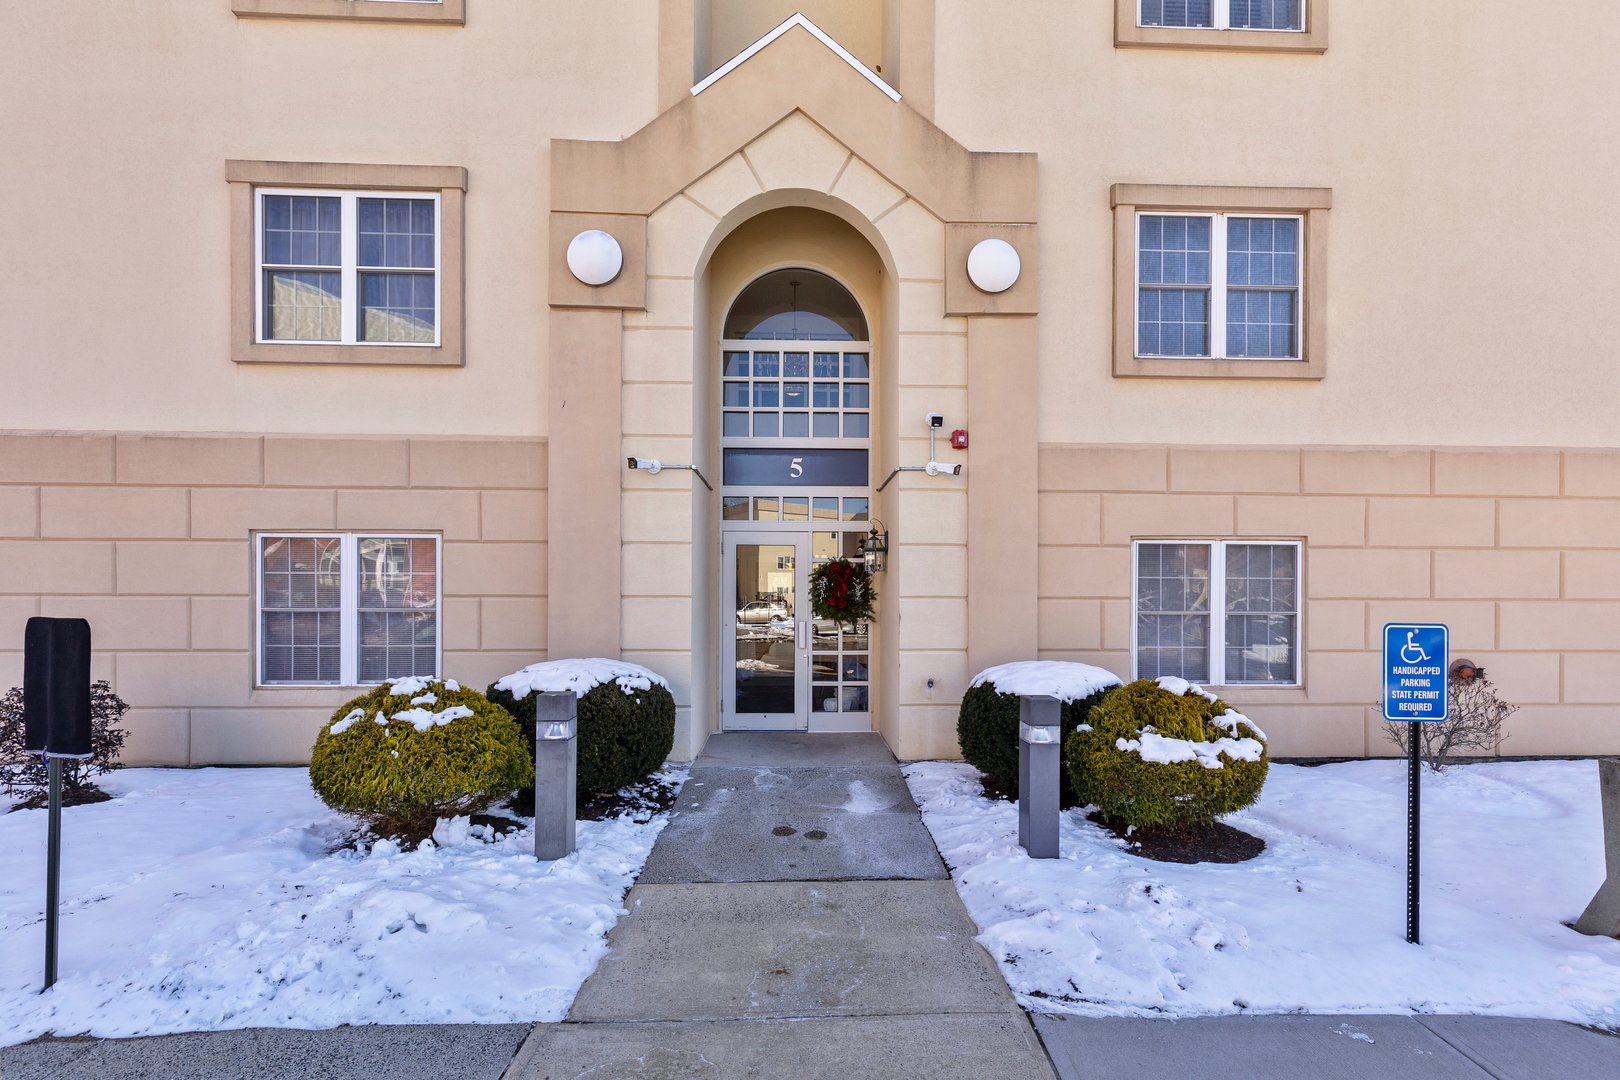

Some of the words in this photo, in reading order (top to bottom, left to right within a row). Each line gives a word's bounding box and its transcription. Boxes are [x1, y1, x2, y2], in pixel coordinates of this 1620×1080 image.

[790, 457, 803, 478] 5
[1392, 666, 1441, 675] HANDICAPPED
[1400, 678, 1431, 687] PARKING
[1391, 690, 1412, 699] STATE
[1413, 690, 1440, 699] PERMIT
[1398, 702, 1433, 711] REQUIRED
